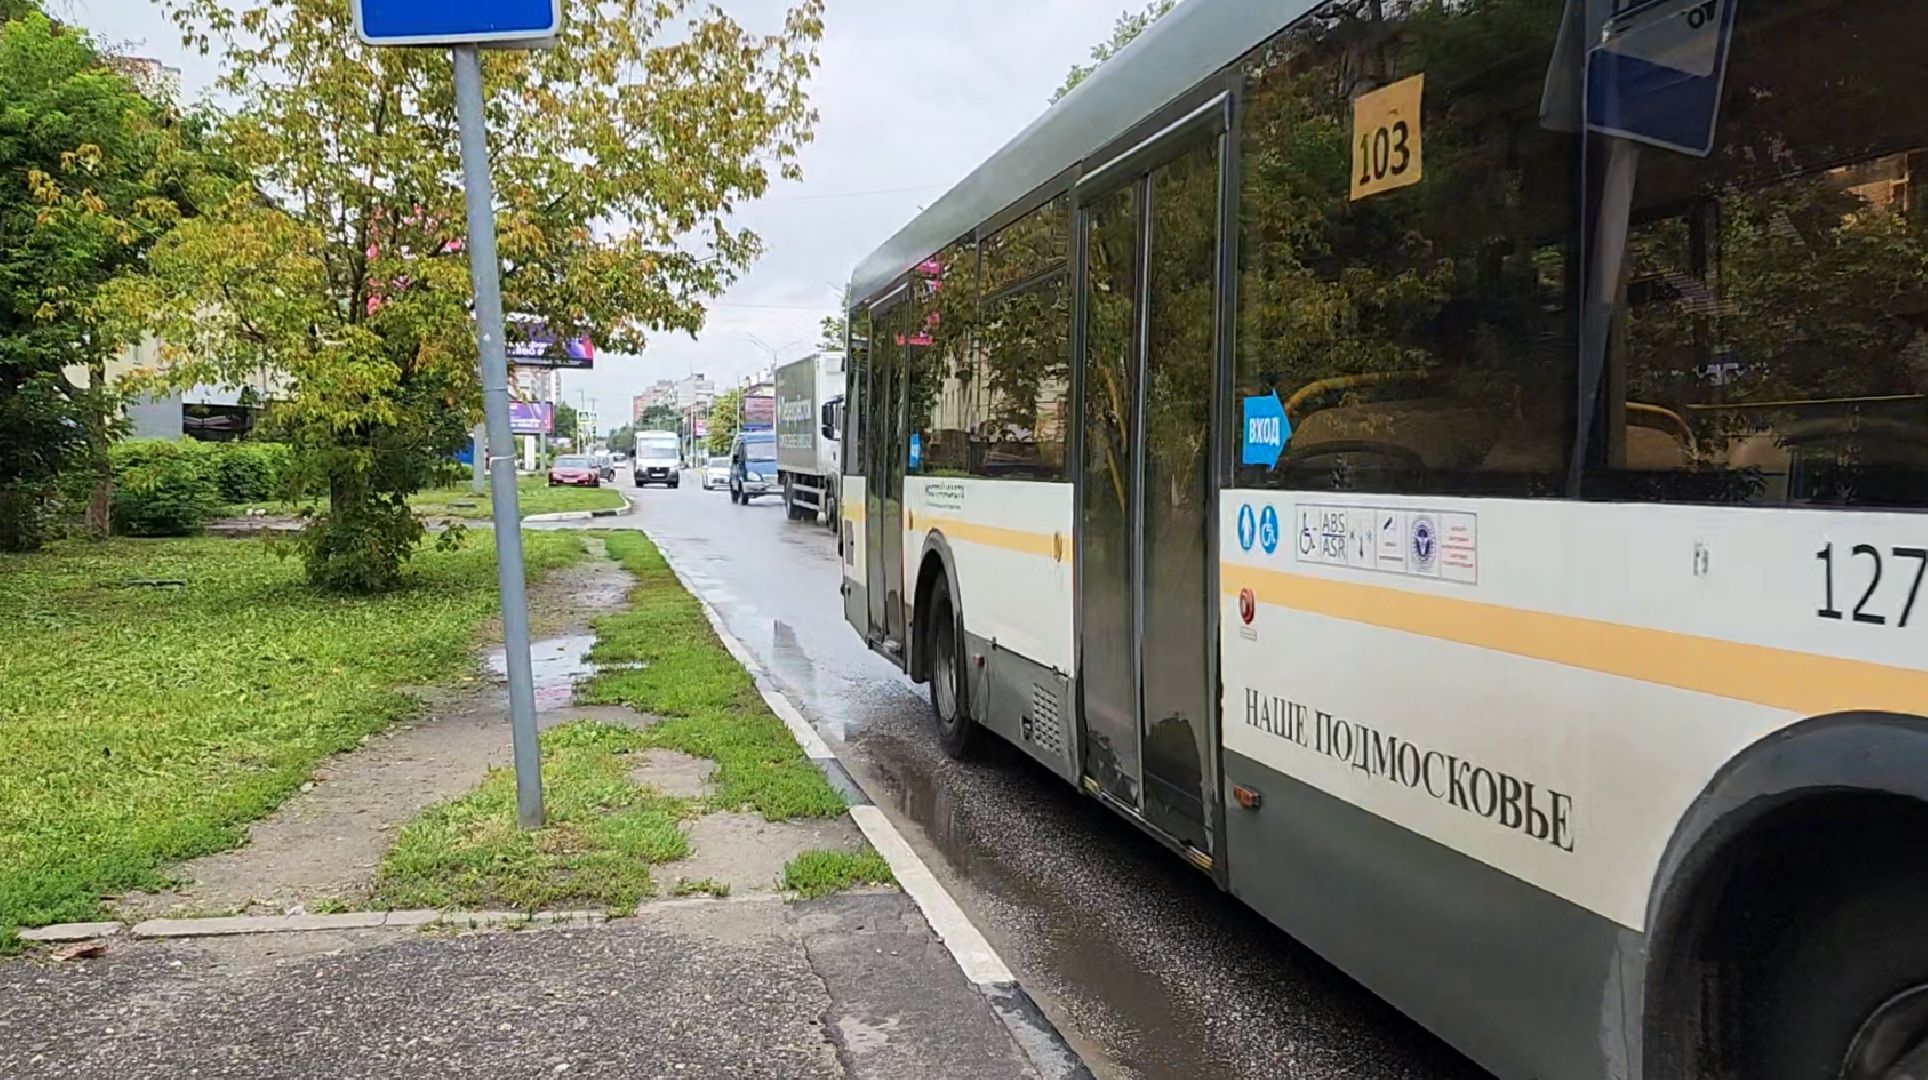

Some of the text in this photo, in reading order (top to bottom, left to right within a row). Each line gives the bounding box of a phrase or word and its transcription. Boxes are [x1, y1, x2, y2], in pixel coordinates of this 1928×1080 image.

[1360, 120, 1411, 185] 103
[1249, 416, 1281, 445] ВХОД
[1322, 512, 1346, 534] ABS
[1322, 538, 1347, 559] ASR
[1816, 541, 1928, 628] 127
[1244, 687, 1575, 853] НАШЕ ПОДМОСКОВЬЕ
